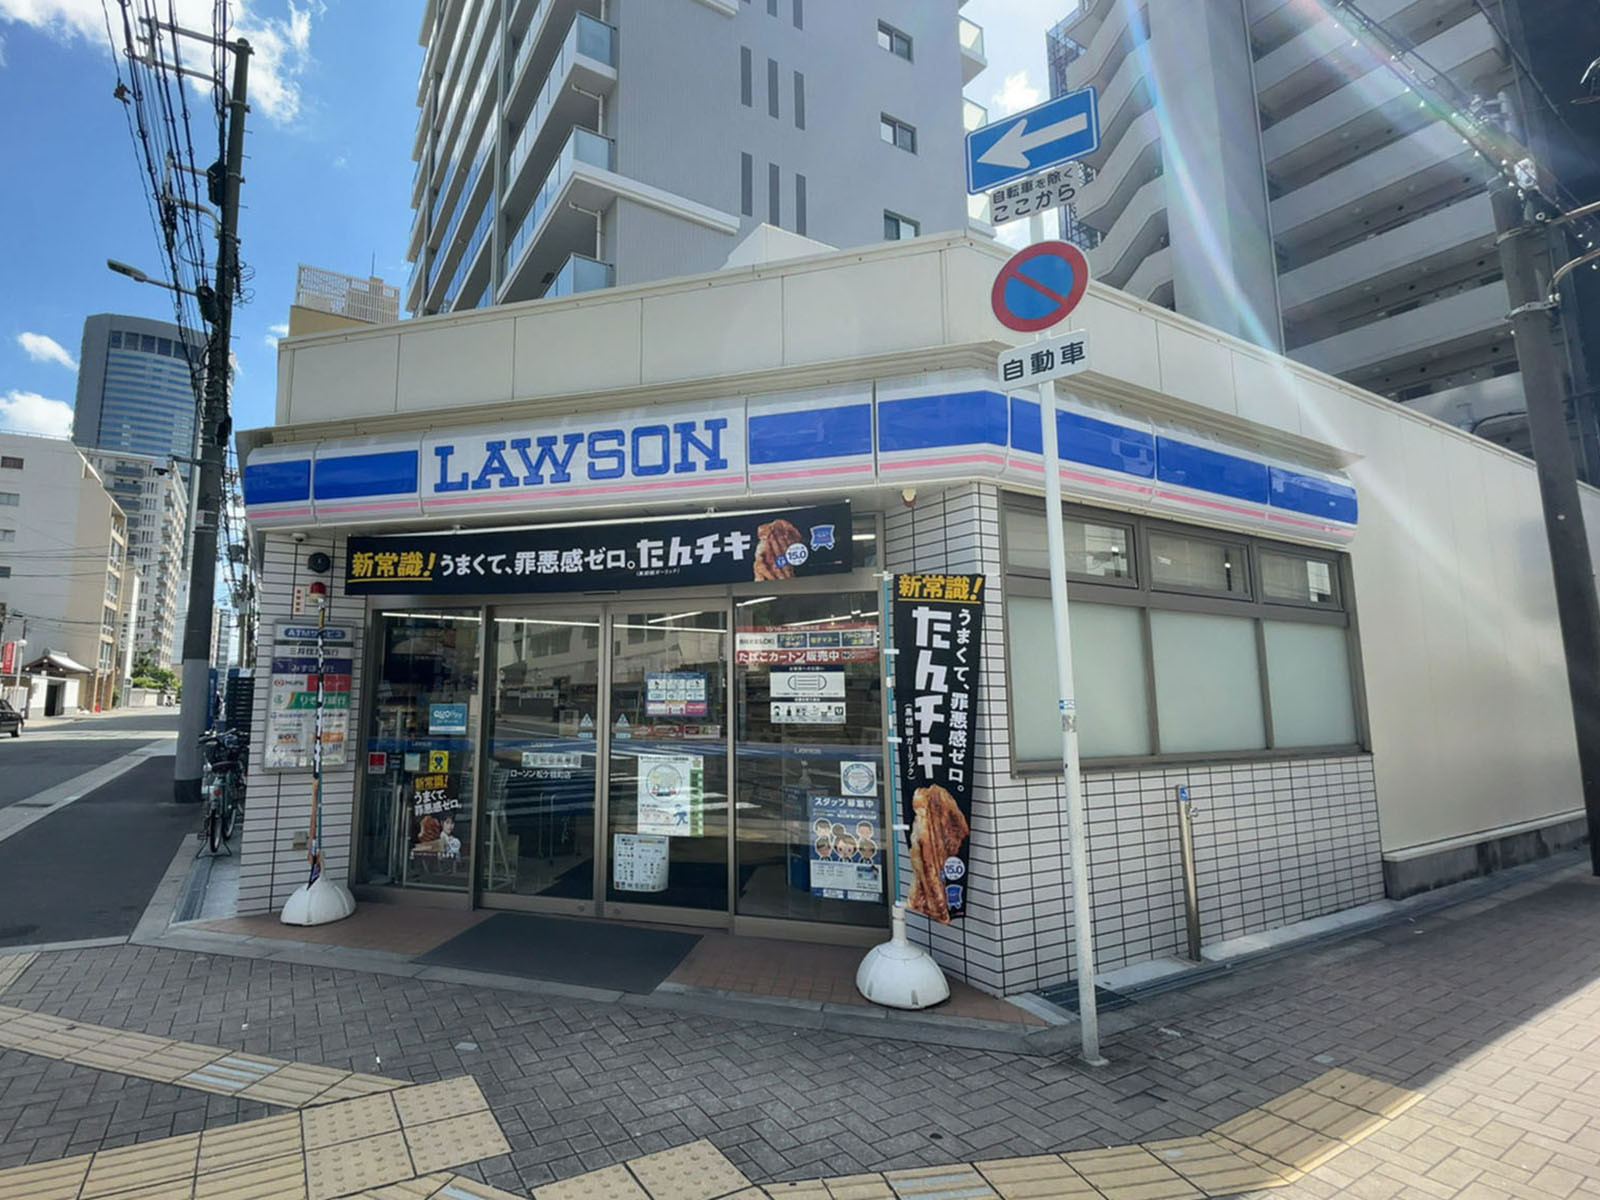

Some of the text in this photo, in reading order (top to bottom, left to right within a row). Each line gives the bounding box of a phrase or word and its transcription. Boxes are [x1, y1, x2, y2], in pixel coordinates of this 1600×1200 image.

[993, 168, 1073, 204] 自転車を除く
[994, 184, 1075, 222] ここから
[1003, 341, 1086, 381] 自動車
[434, 418, 728, 492] LAWSON
[440, 547, 636, 576] うまくて、罪悪感ゼロ。
[636, 531, 751, 568] たんチキ
[912, 606, 952, 779] たんチキ
[948, 608, 972, 792] うまくて、罪悪感ゼロ。
